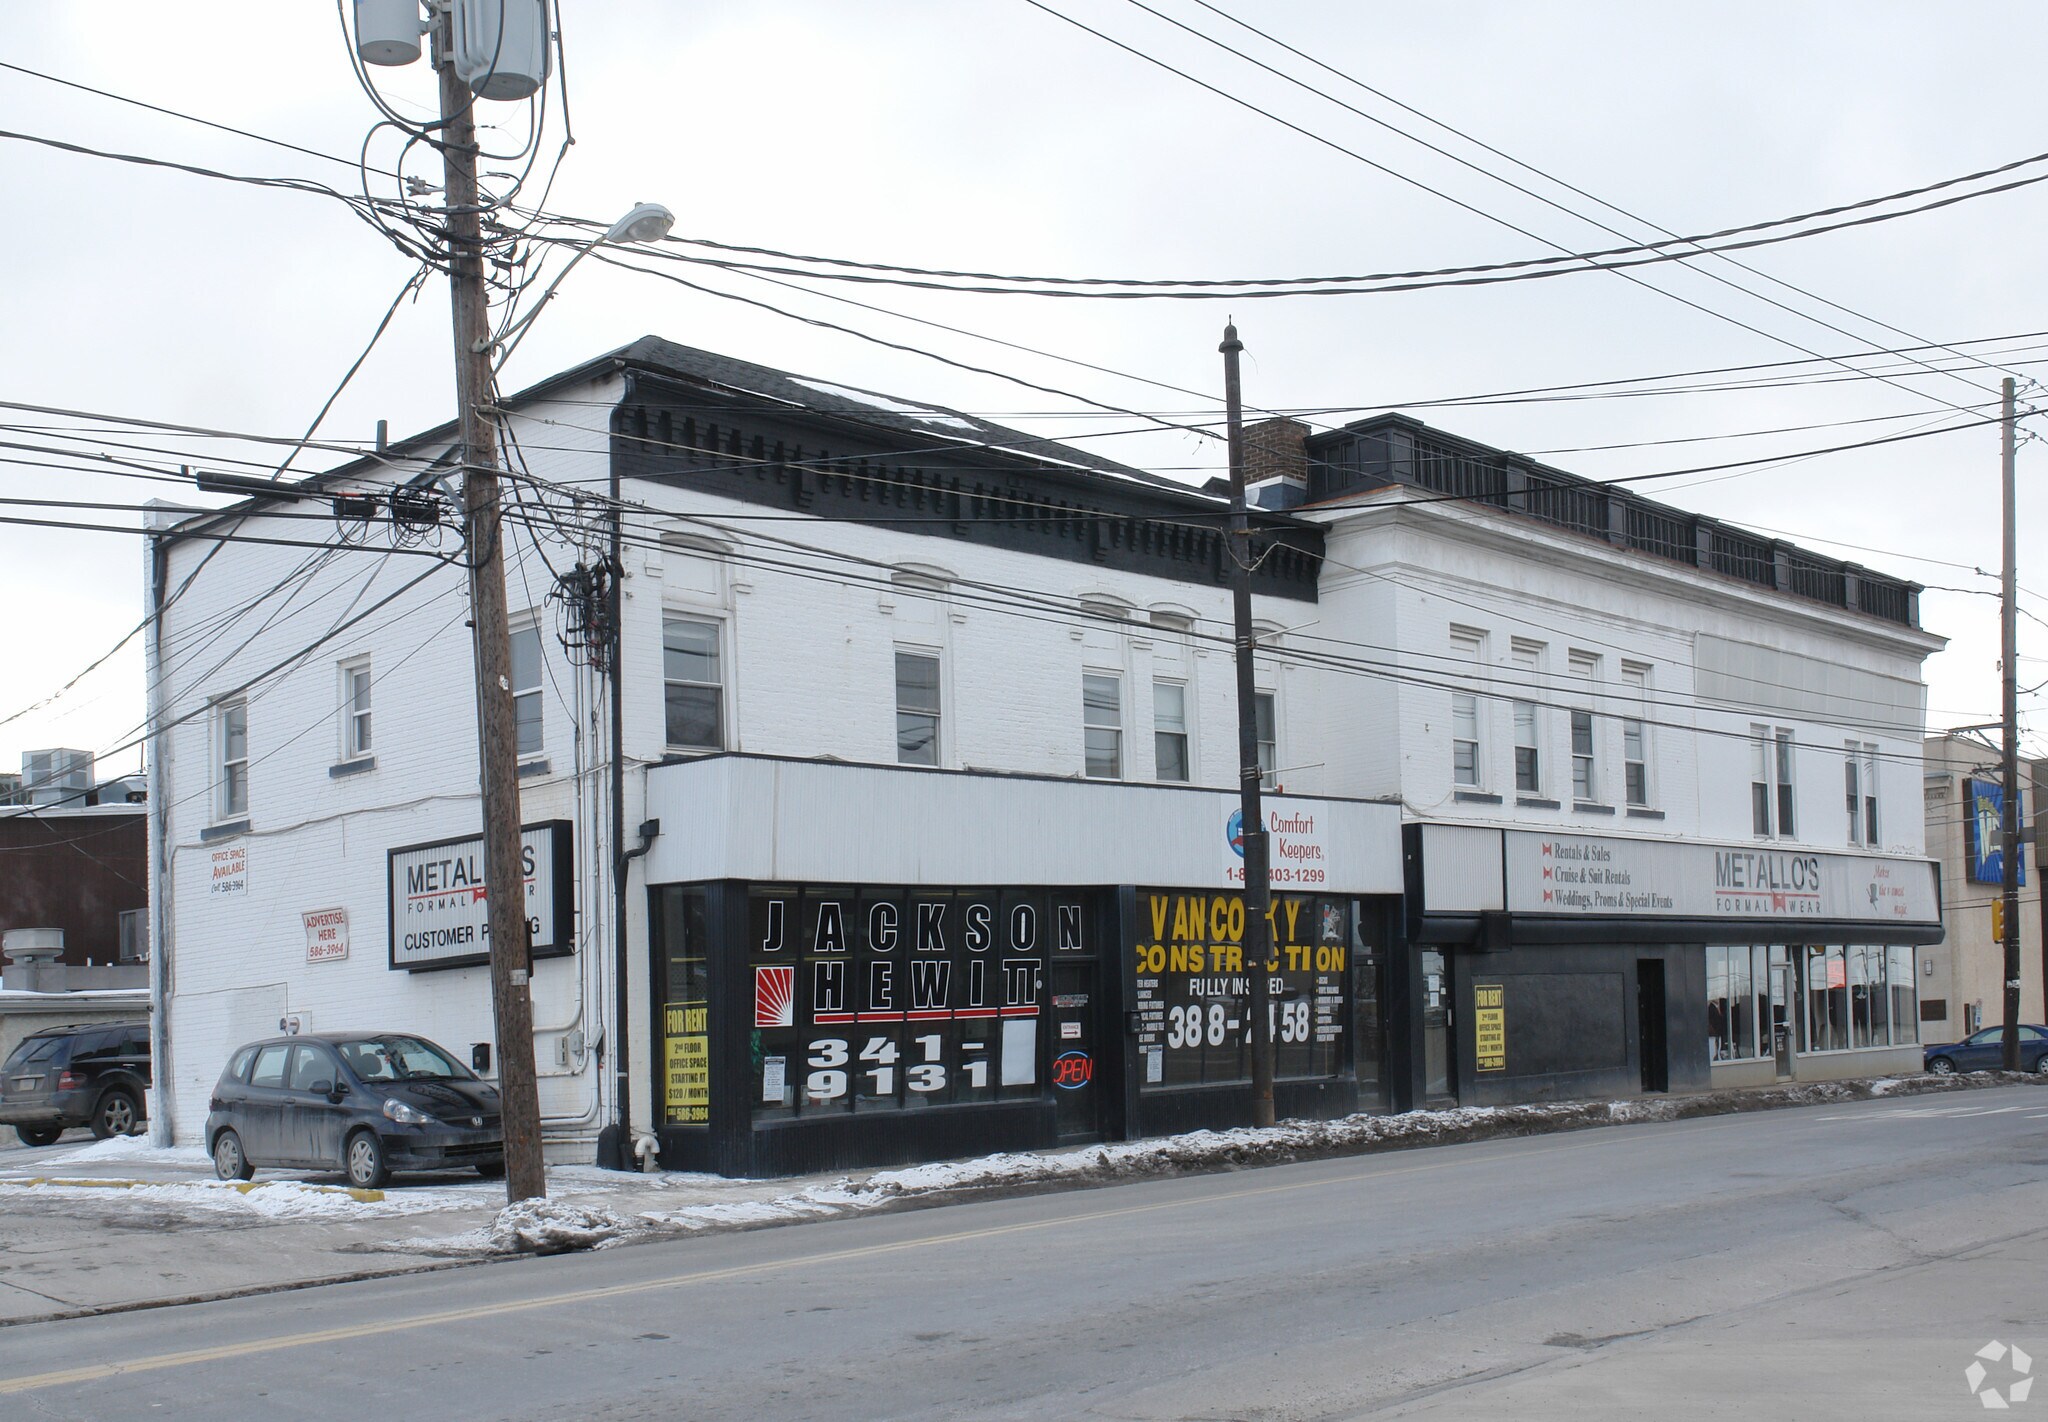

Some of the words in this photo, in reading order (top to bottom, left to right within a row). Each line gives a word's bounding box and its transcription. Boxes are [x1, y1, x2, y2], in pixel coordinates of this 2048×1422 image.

[1271, 811, 1313, 834] Comfort
[212, 851, 228, 862] OFFICE
[230, 848, 245, 859] SPACE
[1280, 838, 1321, 863] Keepers
[1555, 842, 1582, 860] Rentals
[1583, 845, 1590, 860] &
[1592, 845, 1611, 861] Sales
[213, 860, 245, 881] AVAILABLE
[408, 845, 535, 894] METALS
[1226, 867, 1325, 883] 1-8403-1299
[1555, 866, 1578, 883] Cruise
[1580, 867, 1587, 883] &
[1589, 868, 1603, 884] Suit
[1605, 868, 1631, 885] Rentals
[1715, 851, 1819, 891] METALLO'S
[222, 880, 244, 892] 586-3964
[408, 896, 466, 914] FORMAL
[1555, 889, 1593, 910] Weddings,
[1595, 890, 1617, 907] Proms
[1618, 892, 1624, 908] &
[1626, 892, 1650, 911] Special
[1652, 893, 1673, 908] Events
[1717, 898, 1769, 912] FORMAL
[1789, 900, 1820, 914] WEAR
[307, 912, 344, 928] ADVERTISE
[763, 901, 1082, 951] JACKSON
[1151, 896, 1299, 942] VANCOKY
[318, 928, 336, 941] HERE
[405, 925, 474, 950] CUSTOMER
[310, 942, 344, 957] 586-3964
[1136, 945, 1345, 973] CONSTRCTION
[813, 959, 1041, 1010] HEWITT
[1189, 978, 1228, 996] FULLY
[1477, 990, 1488, 1007] FOR
[1488, 989, 1502, 1007] RENT
[667, 1010, 684, 1033] FOR
[685, 1008, 707, 1032] RENT
[684, 1042, 702, 1053] FLOOR
[808, 1034, 984, 1068] 341-
[670, 1058, 688, 1069] OFFICE
[690, 1057, 707, 1068] SPACE
[1053, 1058, 1093, 1083] OPEN
[671, 1073, 698, 1084] STARTING
[699, 1072, 706, 1083] AT
[807, 1061, 988, 1098] 9131
[669, 1088, 683, 1099] $120
[688, 1087, 708, 1098] MONTH
[677, 1107, 709, 1120] 586-3964
